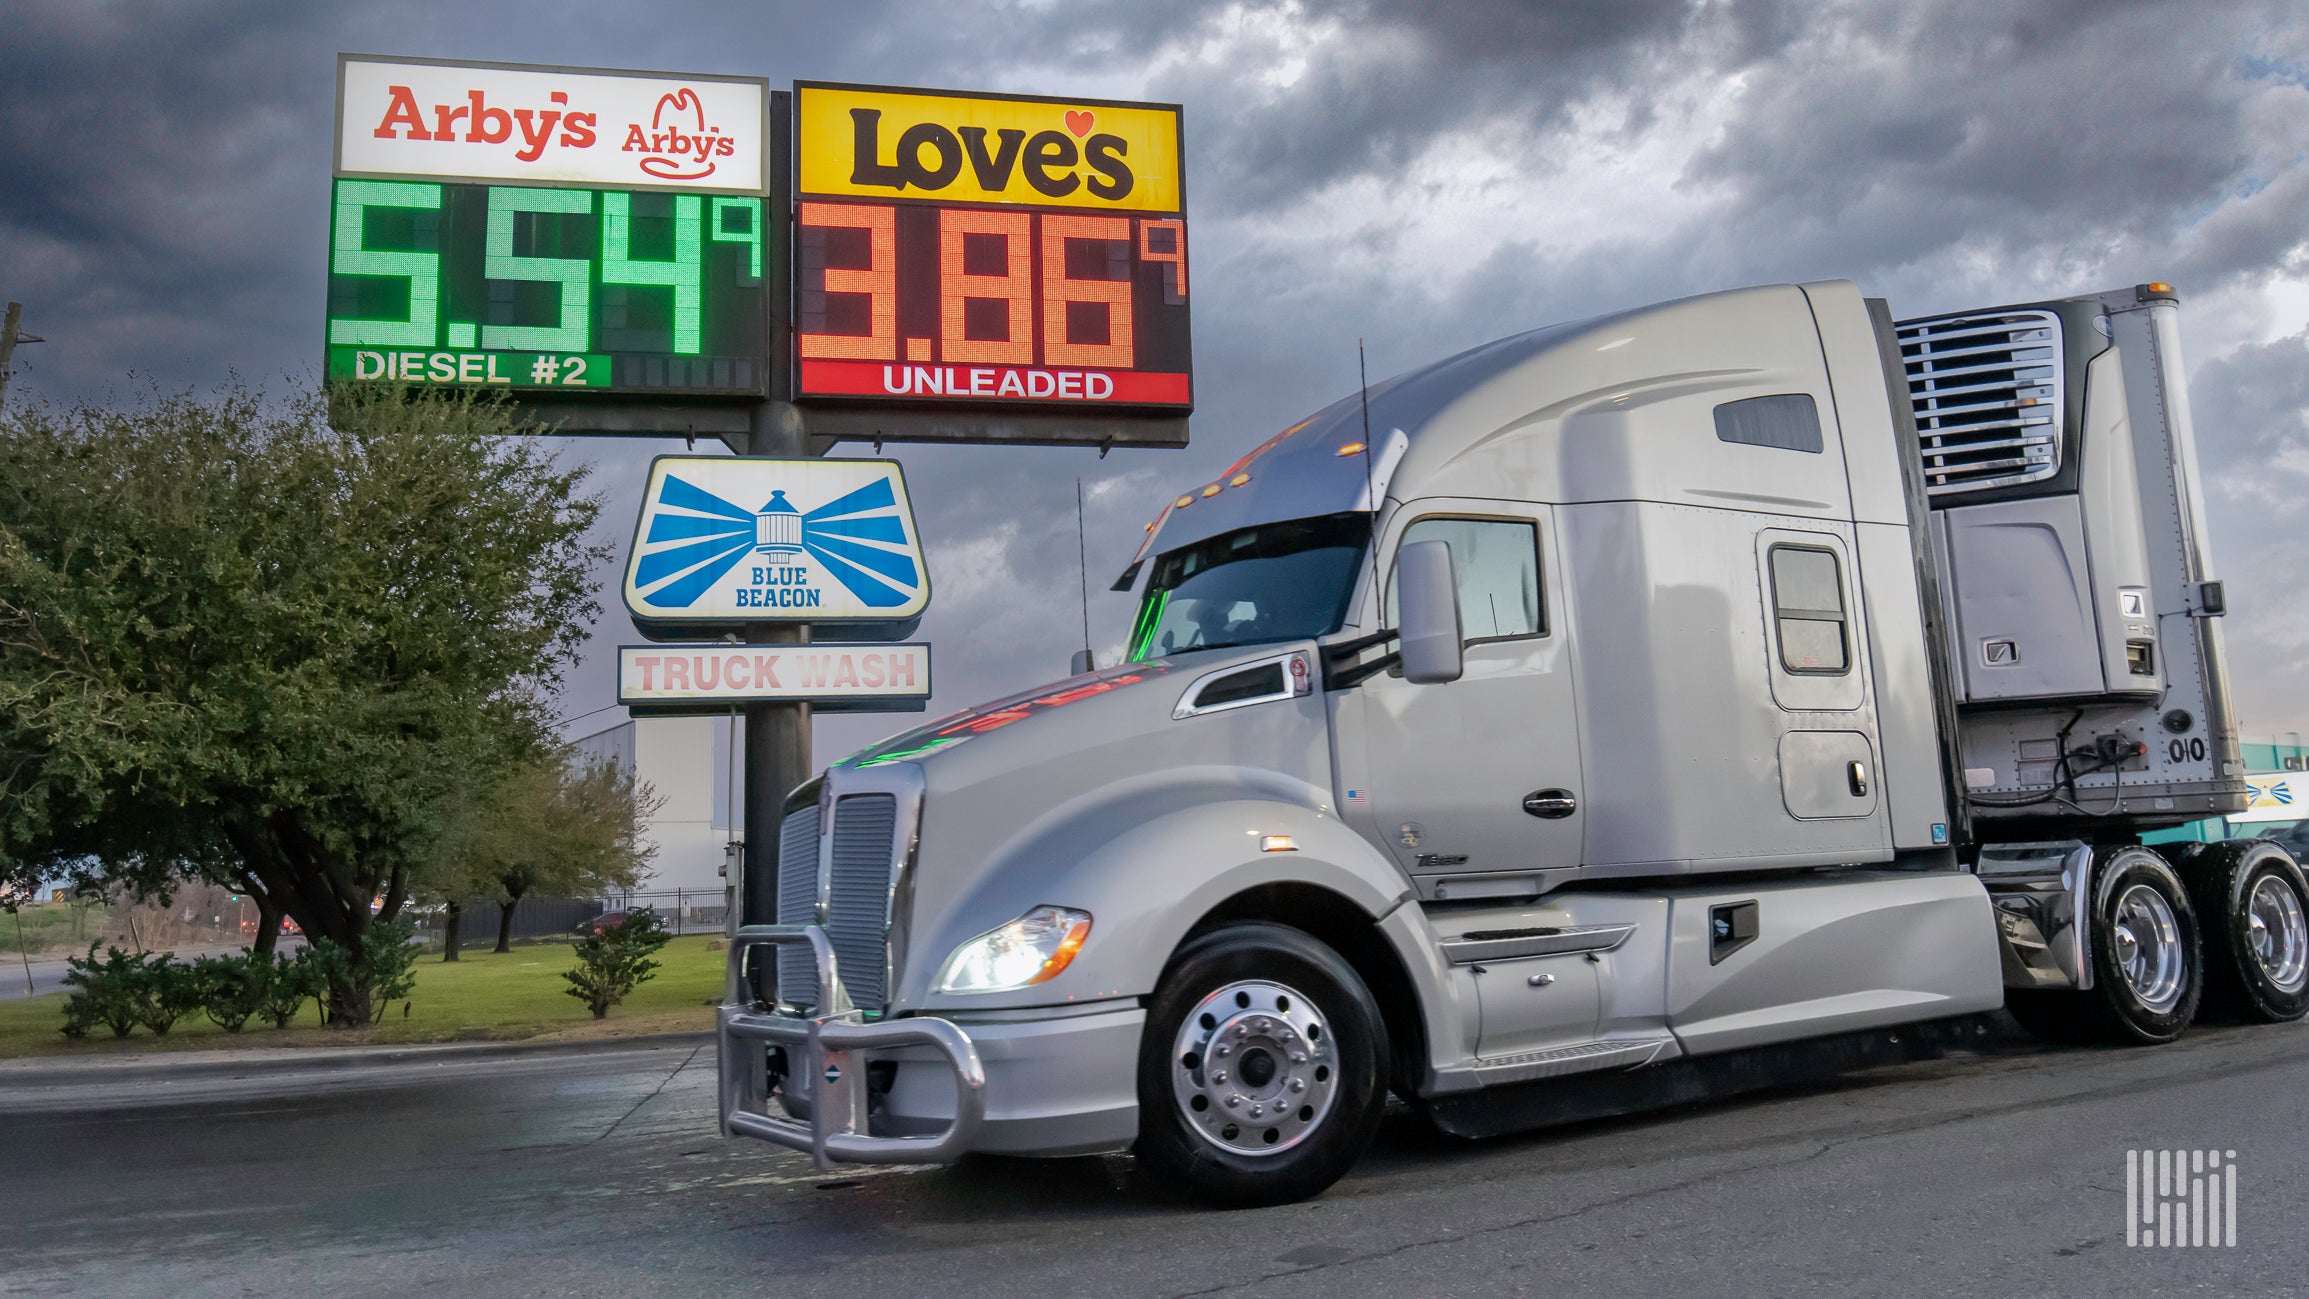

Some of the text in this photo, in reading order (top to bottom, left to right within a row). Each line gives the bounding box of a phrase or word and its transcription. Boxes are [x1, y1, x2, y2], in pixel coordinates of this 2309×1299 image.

[373, 86, 597, 162] Arby's
[621, 124, 735, 163] Arby's
[355, 351, 588, 386] DIESEL #2
[883, 366, 1115, 400] UNLEADED
[751, 567, 807, 586] BLUE
[736, 588, 820, 608] BEACON
[635, 654, 915, 691] TRUCK WASH
